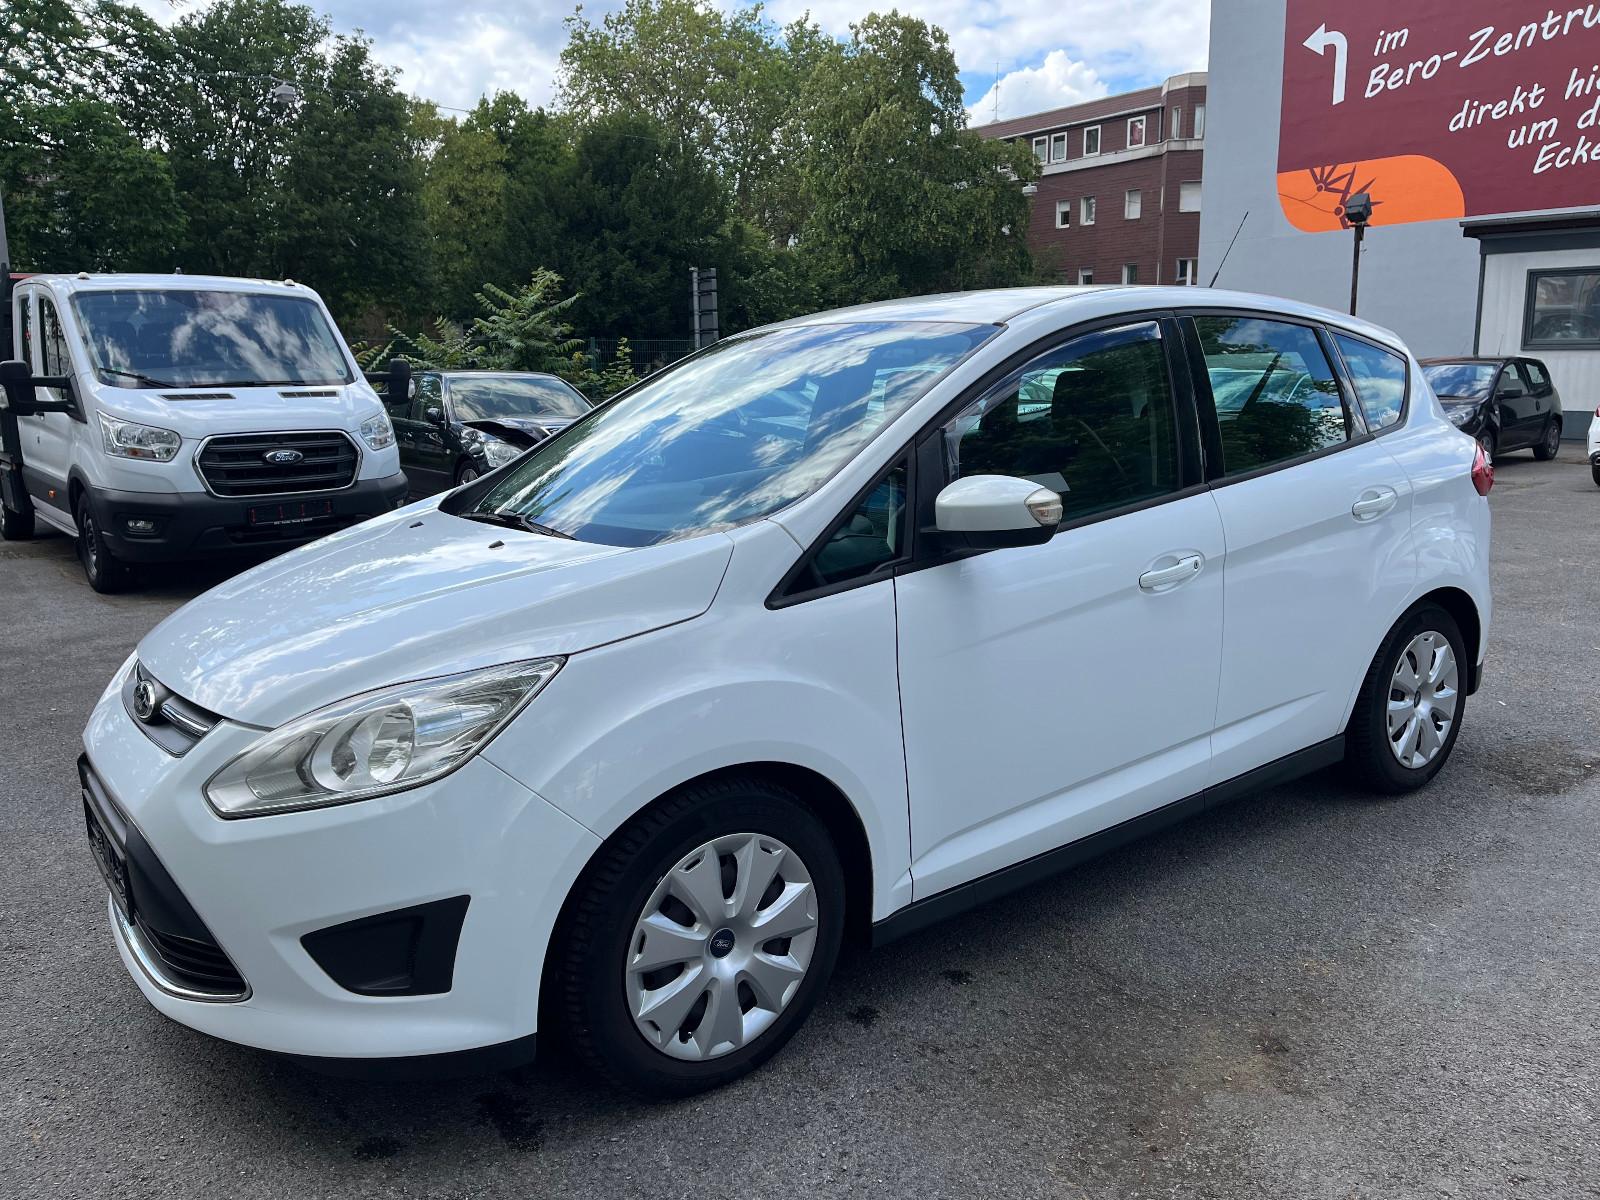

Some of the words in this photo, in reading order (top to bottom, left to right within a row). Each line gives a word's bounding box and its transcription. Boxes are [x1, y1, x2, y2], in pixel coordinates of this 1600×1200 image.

[1374, 28, 1409, 57] im
[1449, 83, 1546, 132] direkt
[1508, 118, 1558, 149] um
